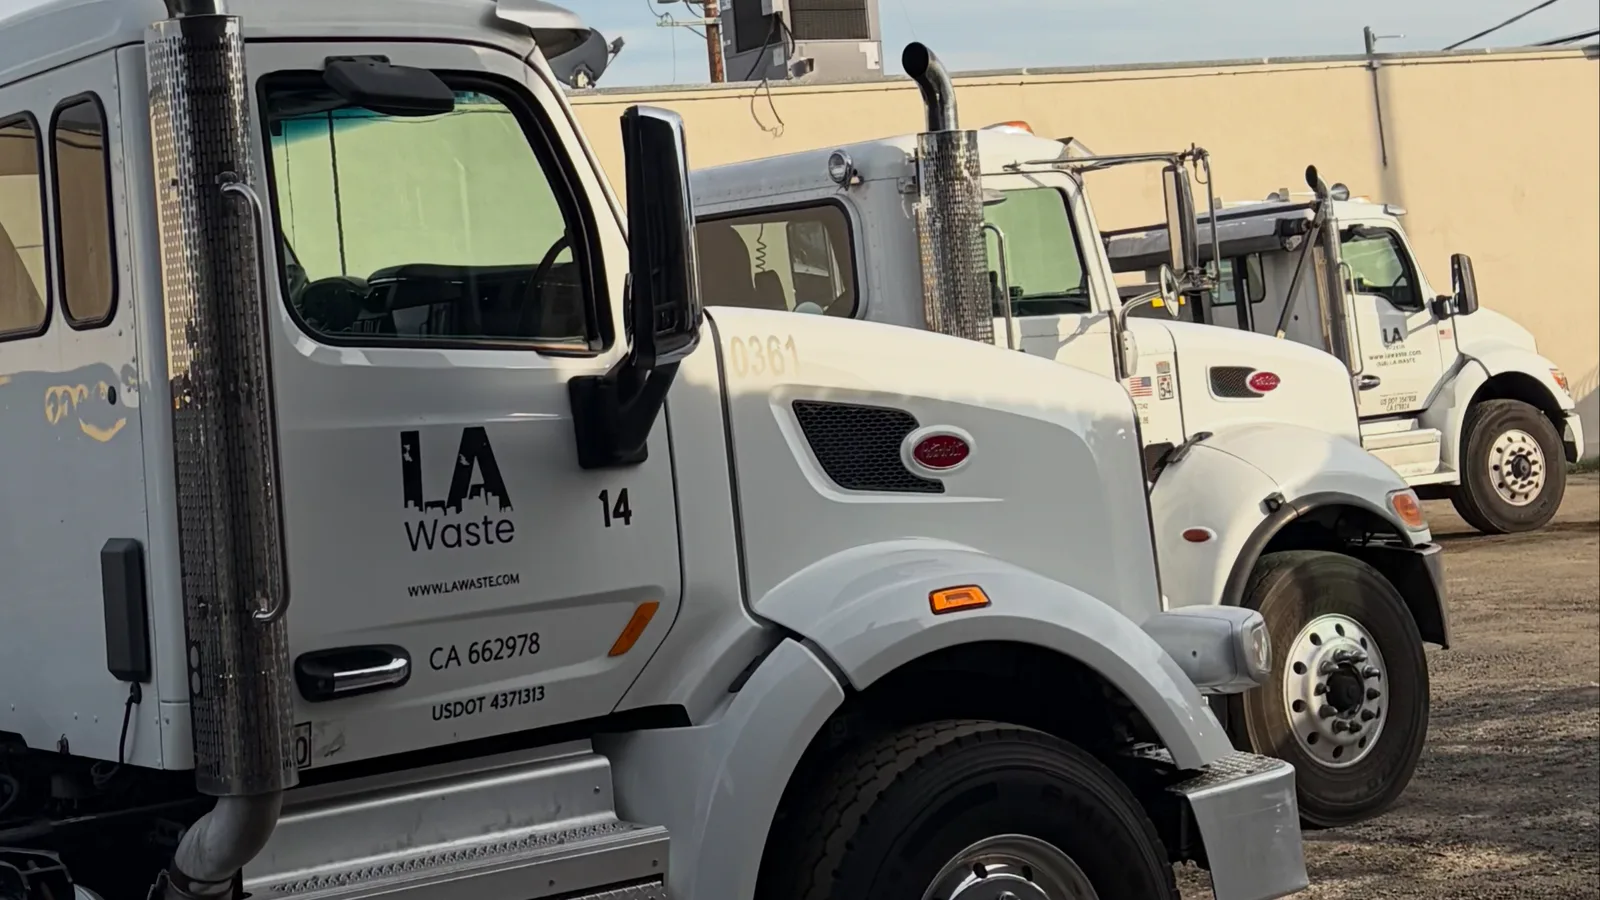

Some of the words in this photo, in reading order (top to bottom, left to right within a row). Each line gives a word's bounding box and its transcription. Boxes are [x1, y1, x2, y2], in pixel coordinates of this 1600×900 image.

[1383, 327, 1404, 344] LA
[730, 334, 800, 378] 0361
[1160, 381, 1172, 397] 54
[400, 426, 514, 516] LA
[598, 488, 632, 528] 14
[404, 515, 515, 552] Waste
[408, 573, 520, 597] WWW.LAWASTE.COM
[429, 645, 462, 670] CA
[468, 632, 541, 664] 662978
[432, 696, 486, 721] USDOT
[490, 685, 545, 710] 4371313
